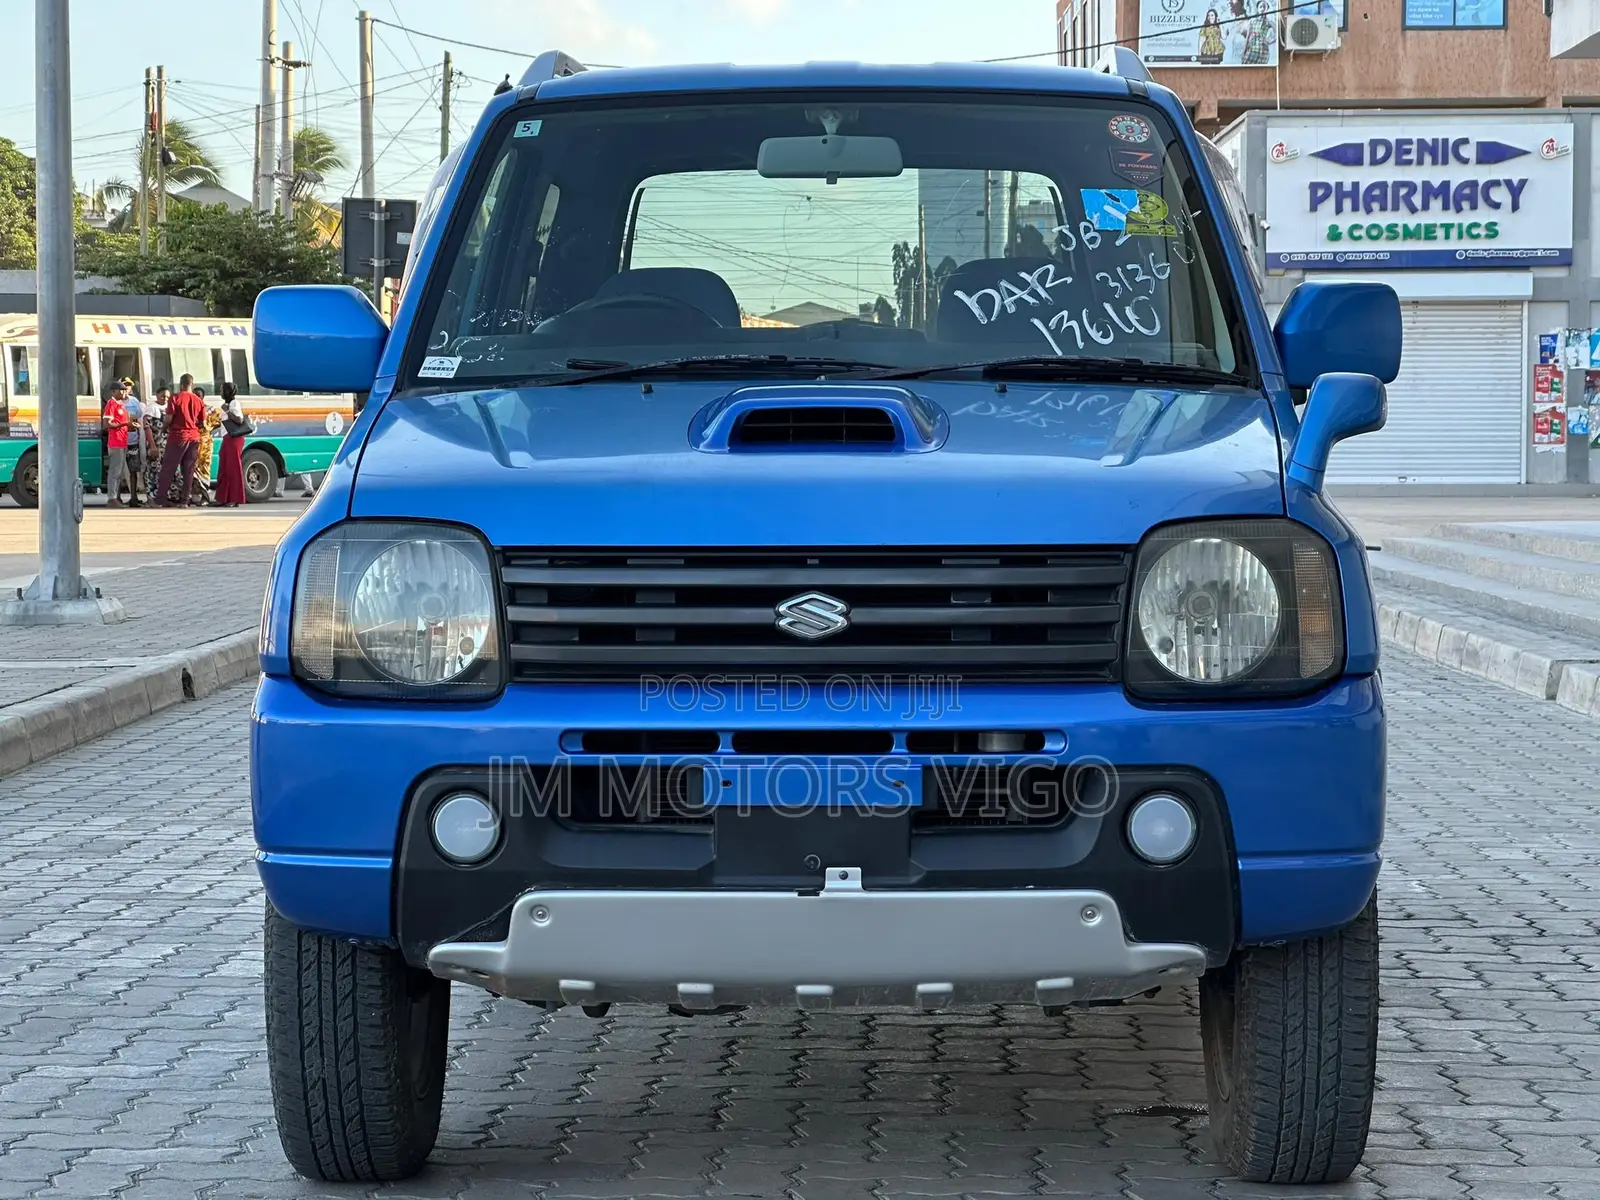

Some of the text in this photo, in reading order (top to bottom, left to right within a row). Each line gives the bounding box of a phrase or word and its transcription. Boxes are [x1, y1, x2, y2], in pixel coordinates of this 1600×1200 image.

[1149, 15, 1198, 23] BIZZLEST
[1275, 148, 1285, 158] 24
[1368, 138, 1471, 166] DENIC
[1545, 143, 1555, 154] 24
[1308, 178, 1529, 215] PHARMACY
[1326, 221, 1500, 241] & COSMETICS
